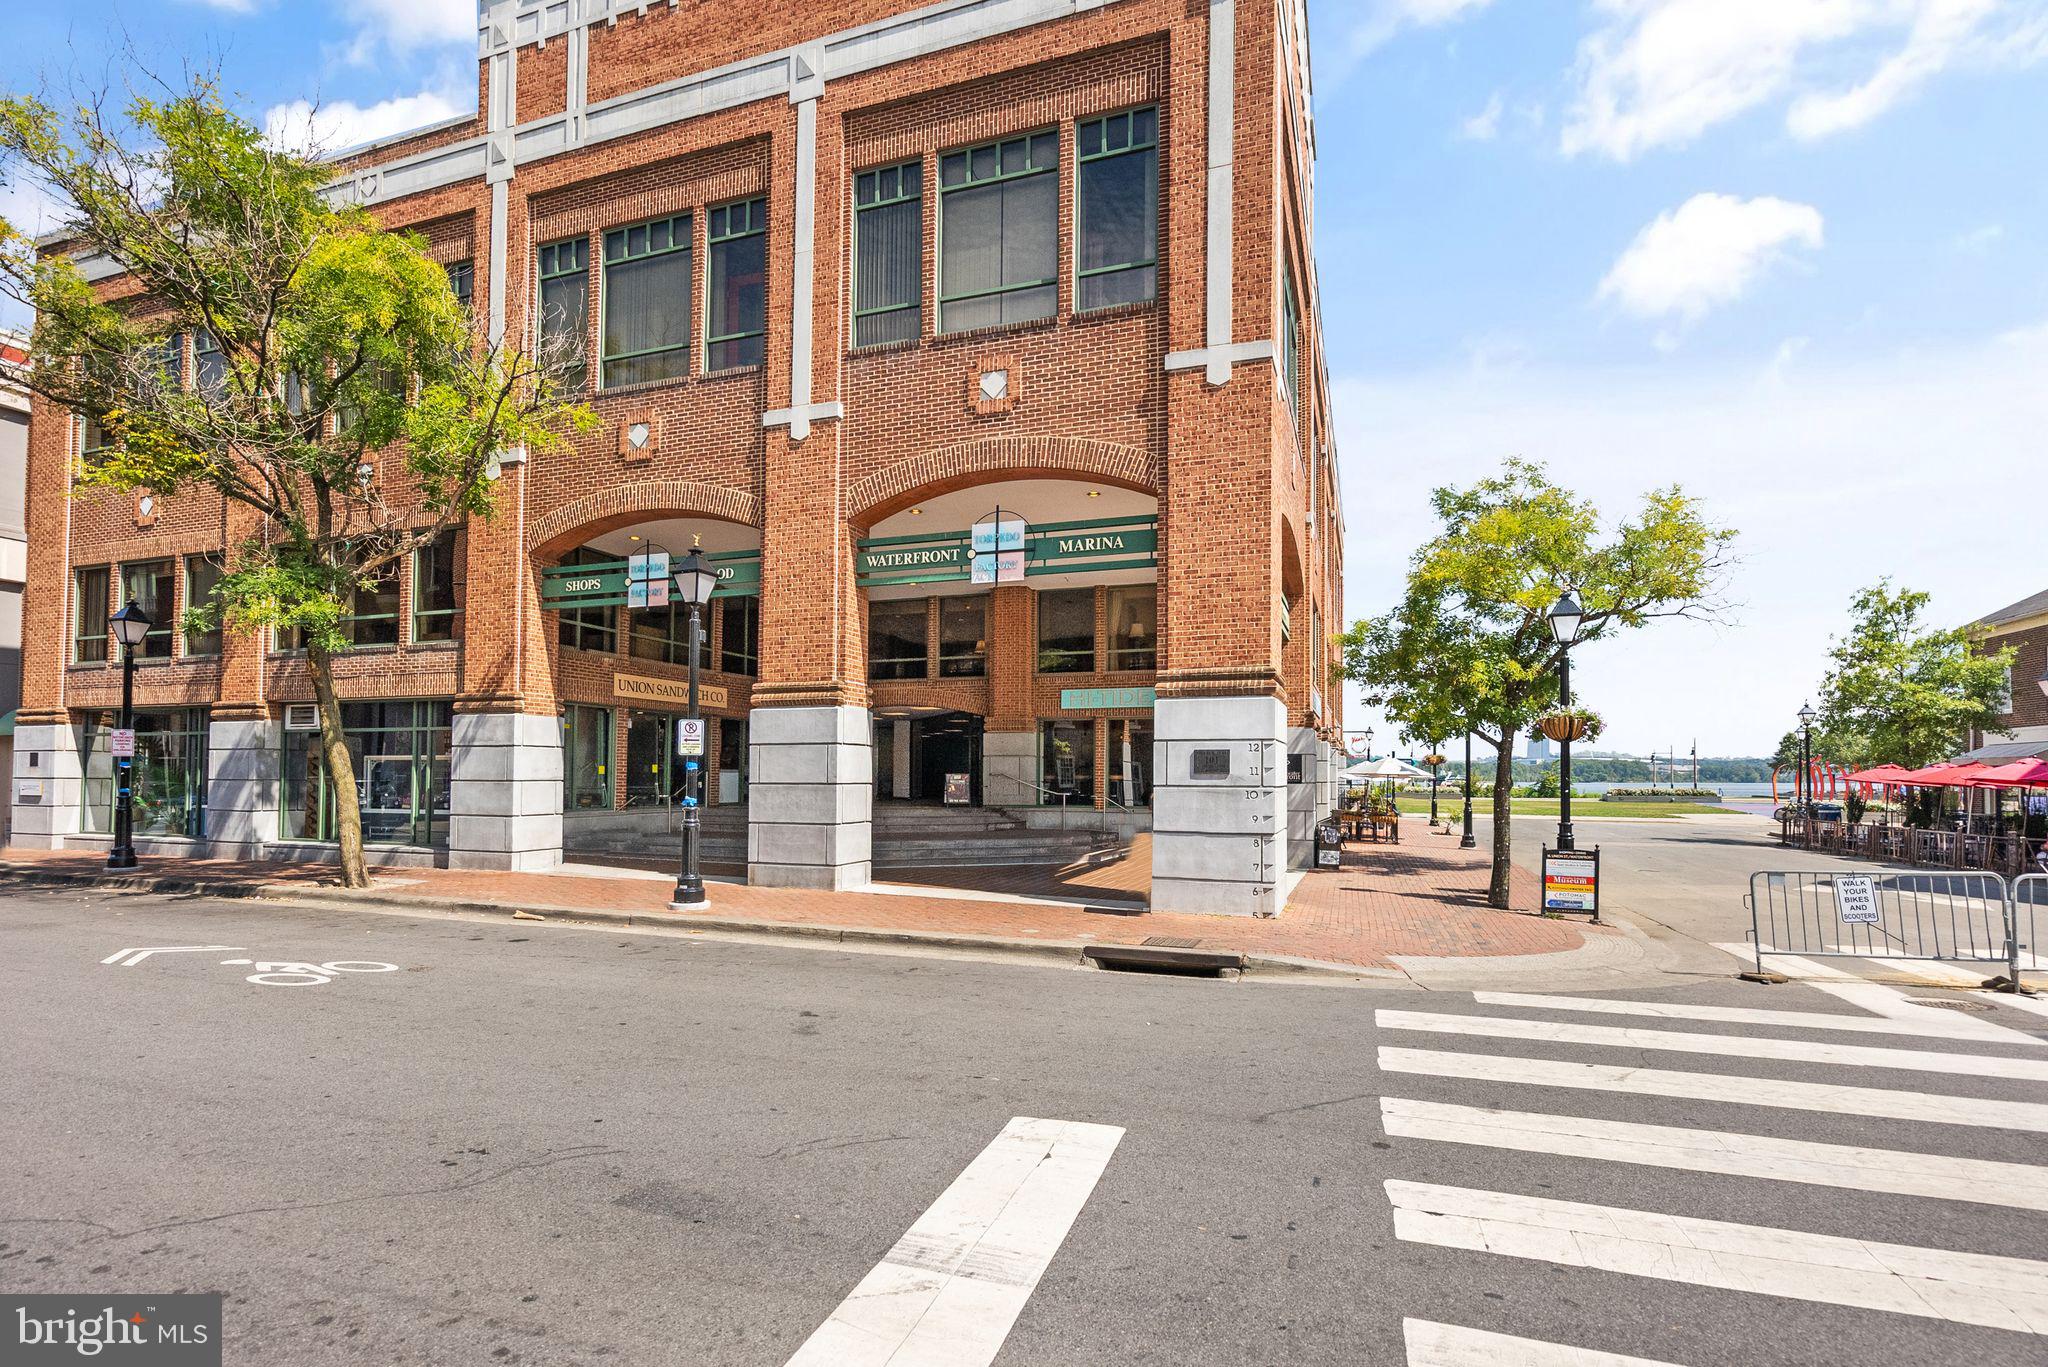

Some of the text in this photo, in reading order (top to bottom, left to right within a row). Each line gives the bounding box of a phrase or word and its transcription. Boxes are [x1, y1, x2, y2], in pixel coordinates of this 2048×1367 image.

[1059, 536, 1124, 553] MARINA
[866, 548, 960, 567] WATERFRONT
[717, 567, 734, 580] OD
[565, 578, 601, 592] SHOPS
[618, 679, 725, 703] UNION SANDH CO.
[1248, 743, 1260, 752] 12
[1249, 766, 1260, 776] 11
[1245, 790, 1259, 800] 10
[1251, 815, 1259, 824] 9
[1253, 838, 1260, 848] 8
[1252, 863, 1260, 872] 7
[1553, 875, 1587, 885] Museum
[1252, 887, 1259, 896] 6
[1844, 912, 1876, 920] SCOOTERS
